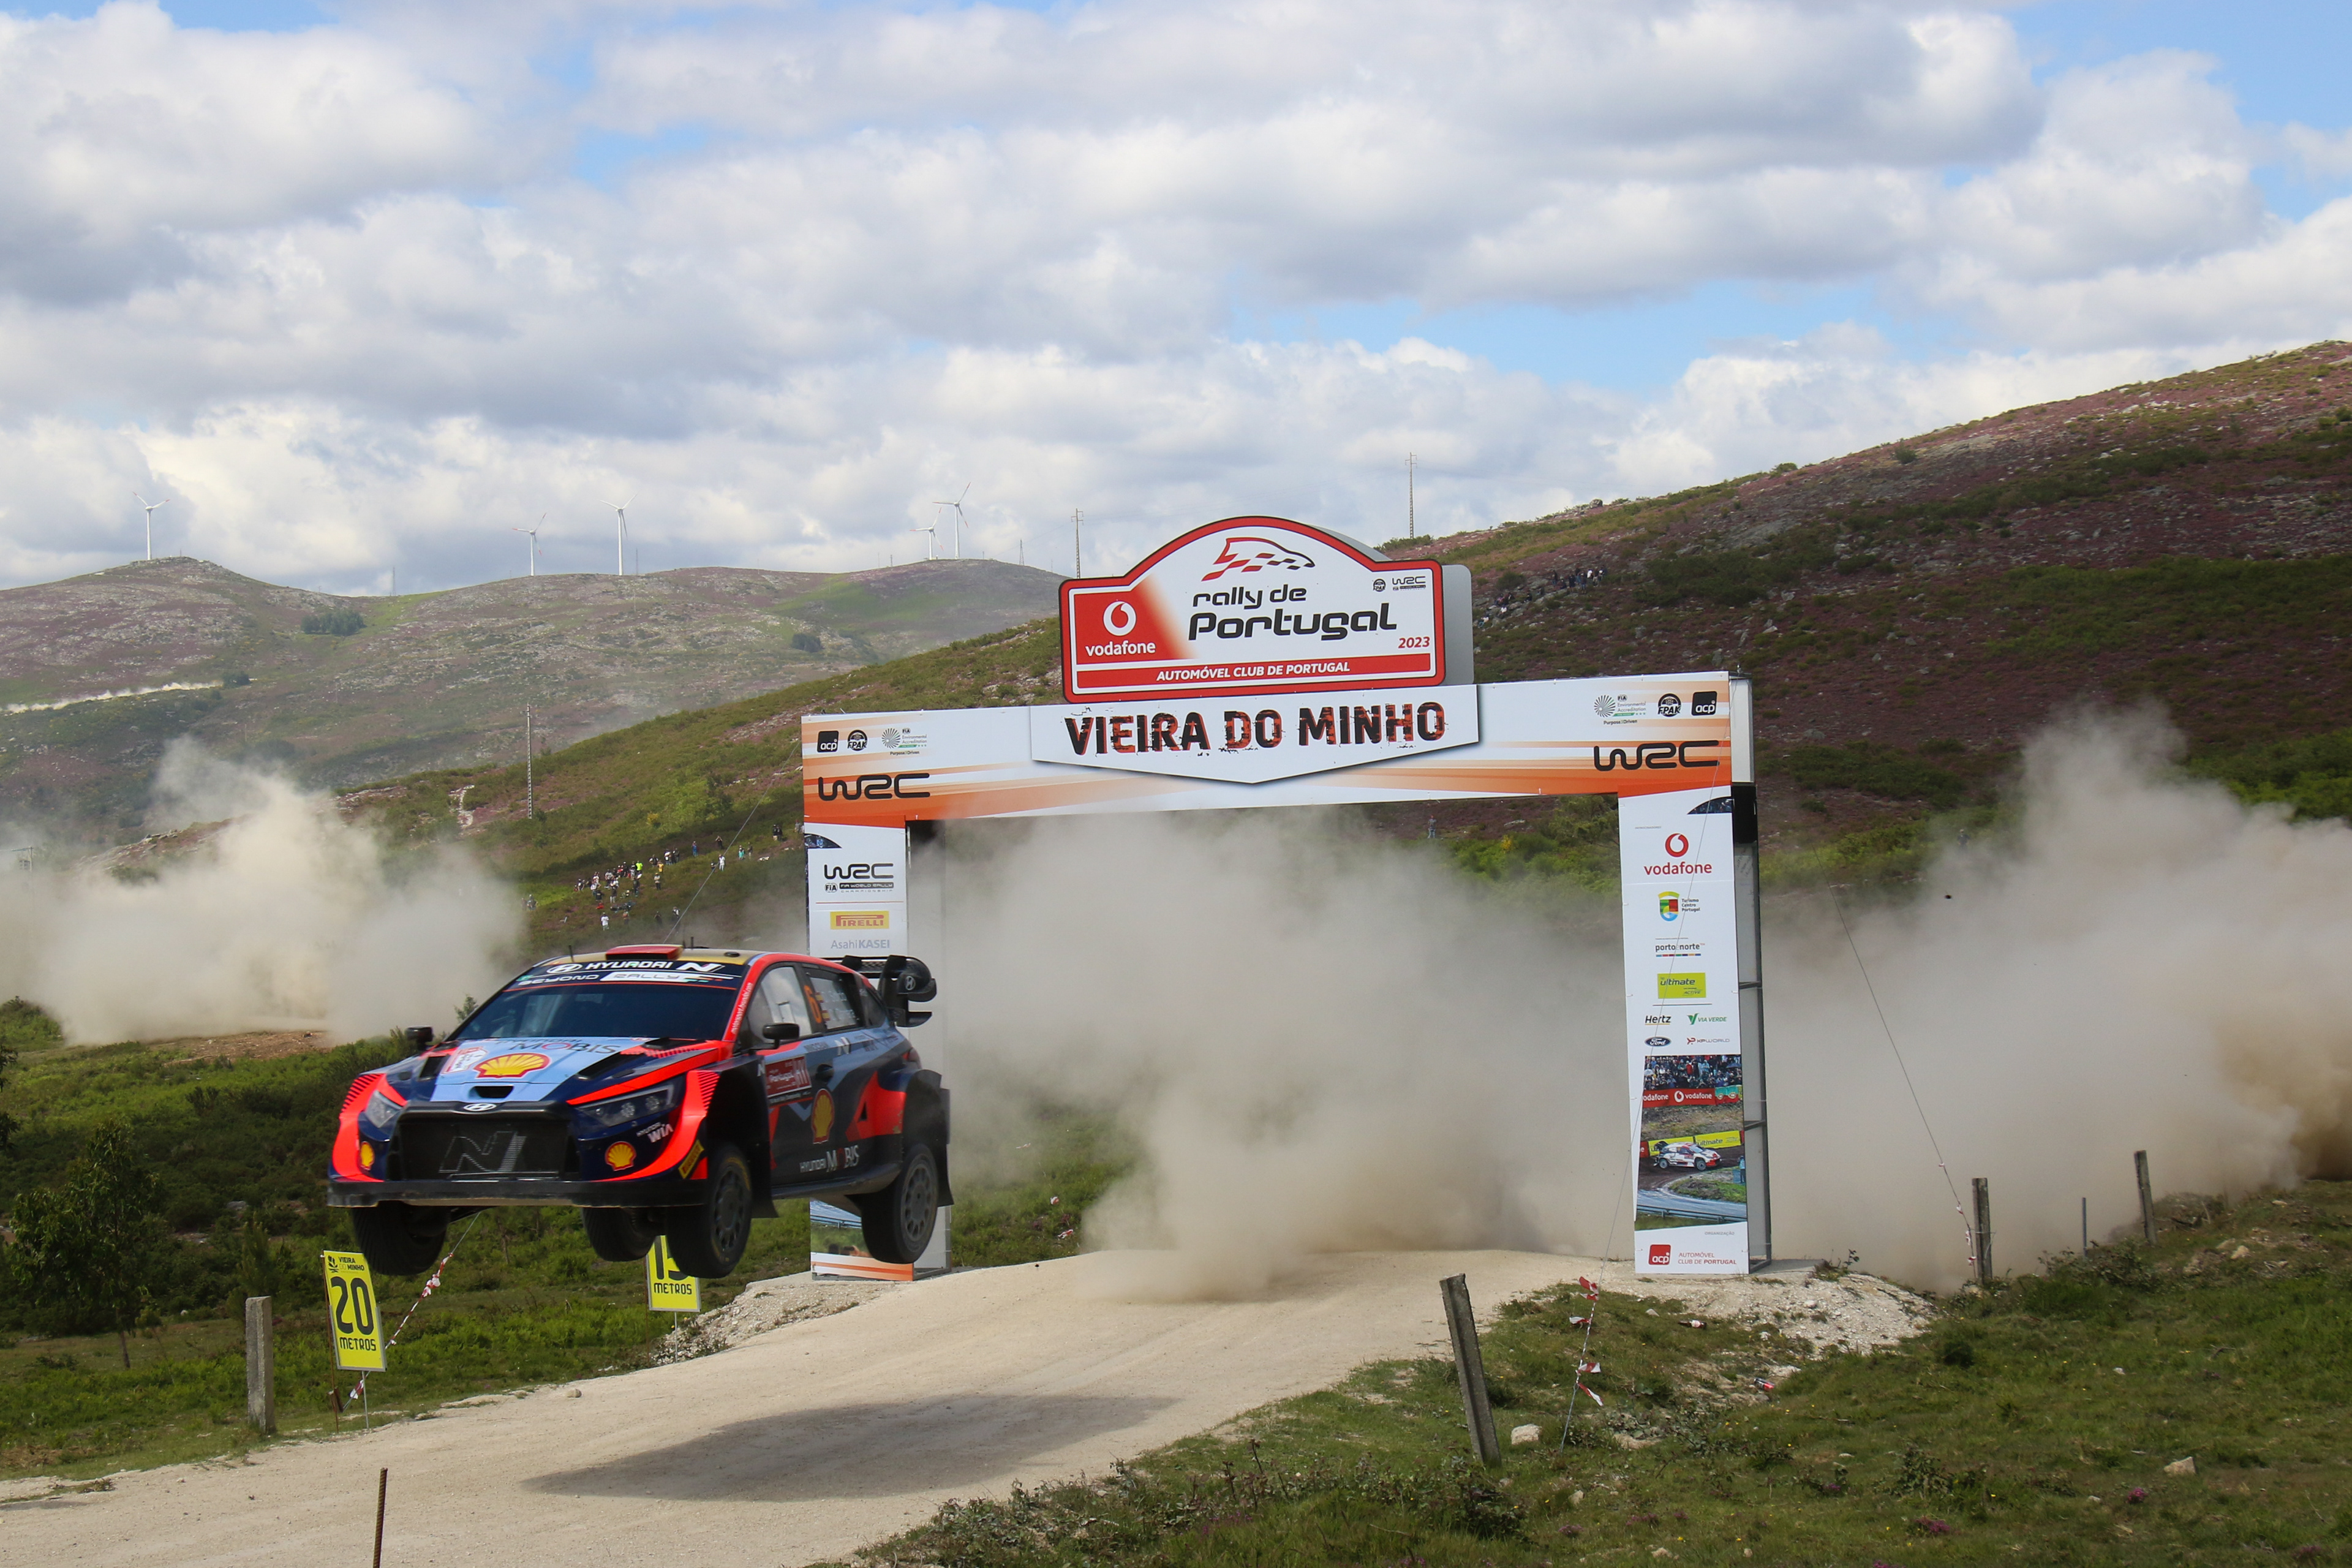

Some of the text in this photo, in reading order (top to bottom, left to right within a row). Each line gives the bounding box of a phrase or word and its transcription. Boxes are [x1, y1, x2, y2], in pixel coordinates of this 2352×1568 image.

[1392, 576, 1426, 585] WRC
[1193, 584, 1307, 610] rally de
[1188, 603, 1397, 641] Portugal
[1085, 640, 1156, 657] vodafone
[1398, 636, 1430, 649] 2023
[1156, 662, 1351, 681] AUTOMÓVEL CLUB DE PORTUGAL
[1657, 706, 1680, 715] FPAK
[1695, 704, 1715, 714] acp
[1065, 701, 1446, 755] VIEIRA DO MINHO
[820, 742, 837, 751] acp
[847, 741, 867, 749] FPAK
[1594, 740, 1720, 771] WRC
[818, 773, 930, 801] WRC
[824, 863, 894, 880] WRC
[1644, 861, 1713, 875] vodafone
[836, 914, 884, 927] PIRELLI
[584, 960, 674, 971] HYUNDAI
[518, 974, 600, 986] BEYOND
[804, 984, 822, 1023] 6
[1645, 1015, 1672, 1023] Hertz
[509, 1042, 621, 1054] MOBIS
[1652, 1256, 1669, 1264] acp
[654, 1283, 692, 1295] METROS
[330, 1276, 374, 1336] 20
[339, 1337, 377, 1352] METROS
